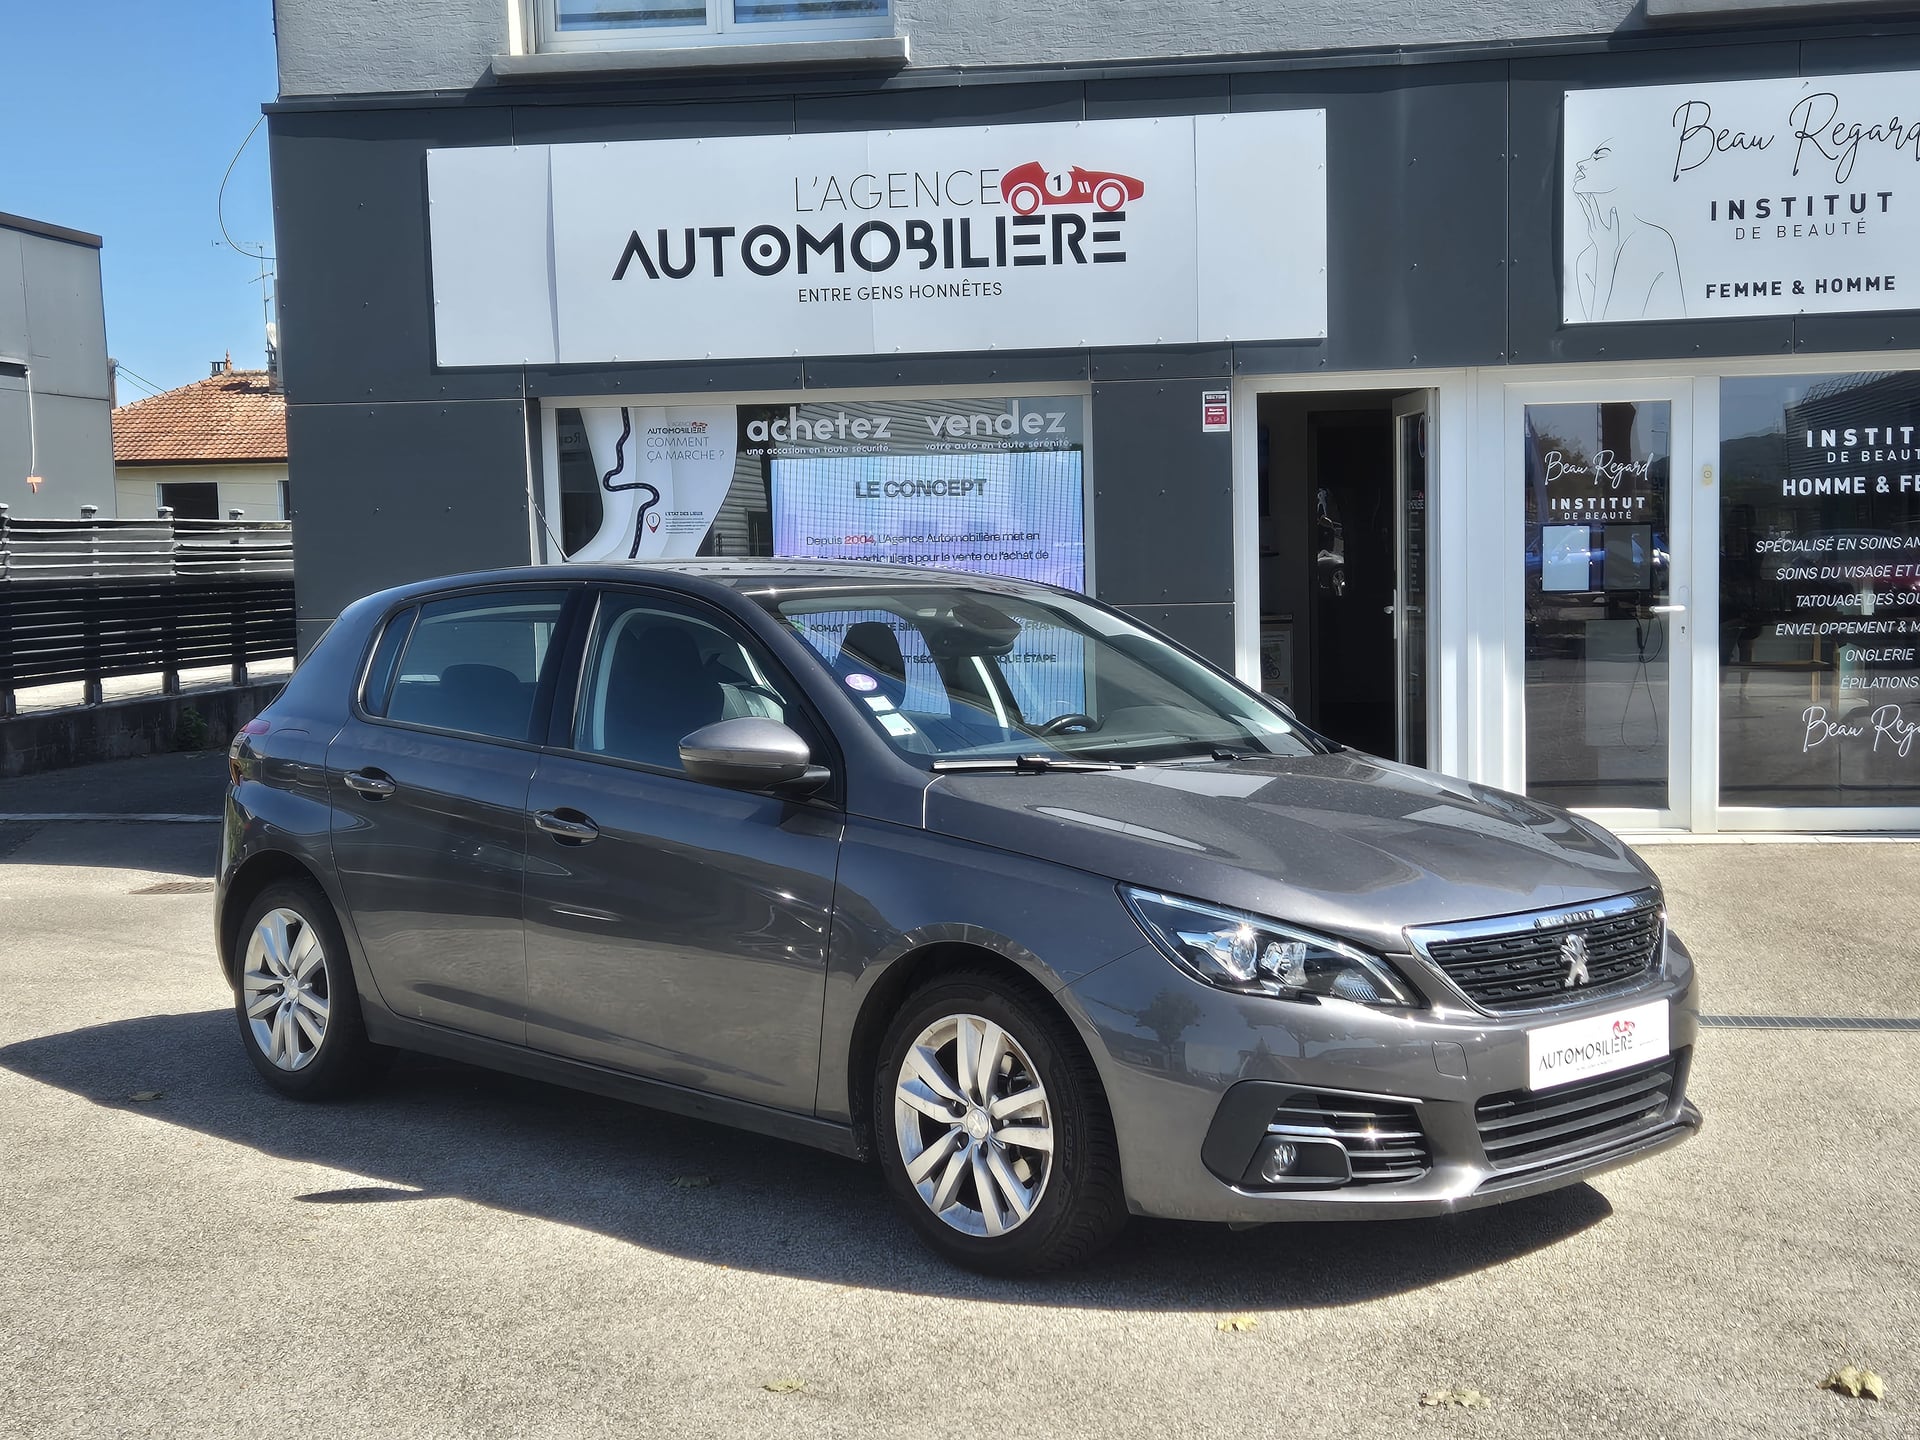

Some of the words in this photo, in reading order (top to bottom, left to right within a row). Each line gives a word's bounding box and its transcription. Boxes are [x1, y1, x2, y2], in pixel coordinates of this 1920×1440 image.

[1672, 100, 1775, 183] Beau
[795, 168, 1001, 212] L'AGENCE
[1710, 191, 1894, 221] INSTITUT
[1735, 225, 1762, 240] DE
[1777, 217, 1867, 239] BEAUTÉ
[798, 287, 852, 303] ENTRE
[857, 285, 904, 301] GENS
[909, 278, 1003, 299] HONNÊTES
[1705, 280, 1782, 298] FEMME
[1791, 279, 1806, 295] &
[1814, 275, 1896, 294] HOMME
[746, 406, 892, 442] achetez
[924, 399, 1066, 437] vendez
[646, 436, 710, 448] COMMENT
[746, 448, 765, 456] une
[766, 445, 806, 455] occasion
[808, 446, 821, 454] en
[823, 445, 849, 453] toute
[851, 442, 892, 453] sécurité.
[924, 441, 950, 450] votre
[954, 441, 979, 450] auto
[981, 441, 994, 449] en
[998, 439, 1025, 449] toute
[646, 450, 663, 464] ÇA
[665, 449, 716, 461] MARCHE
[718, 449, 726, 460] ?
[1827, 451, 1849, 463] DE
[1544, 450, 1588, 486] Beau
[1592, 449, 1655, 489] Regard
[855, 480, 881, 498] LE
[883, 478, 988, 498] CONCEPT
[1782, 476, 1866, 496] HOMME
[1875, 475, 1890, 493] &
[1551, 496, 1646, 510] INSTITUT
[1564, 512, 1578, 520] DE
[1585, 509, 1632, 520] BEAUTÉ
[806, 535, 842, 548] Depuis
[844, 534, 877, 546] 2004,
[878, 534, 924, 546] L'Agence
[926, 531, 1000, 543] Automobilière
[1002, 531, 1024, 541] met
[1026, 532, 1040, 541] en
[1755, 536, 1835, 553] SPÉCIALISÉ
[1836, 538, 1857, 550] EN
[1858, 536, 1902, 550] SOINS
[914, 554, 940, 565] pour
[941, 551, 950, 562] la
[952, 552, 982, 561] vente
[983, 552, 997, 561] ou
[1035, 550, 1049, 560] de
[1776, 567, 1818, 581] SOINS
[1820, 566, 1841, 580] DU
[1844, 565, 1893, 578] VISAGE
[1894, 564, 1914, 577] ET
[1795, 593, 1864, 608] TATOUAGE
[1865, 592, 1895, 606] DES
[1775, 621, 1896, 636] ENVELOPPEMENT
[1897, 620, 1906, 633] &
[1845, 648, 1916, 662] ONGLERIE
[1840, 675, 1919, 690] ÉPILATIONS
[1802, 705, 1863, 753] Beau
